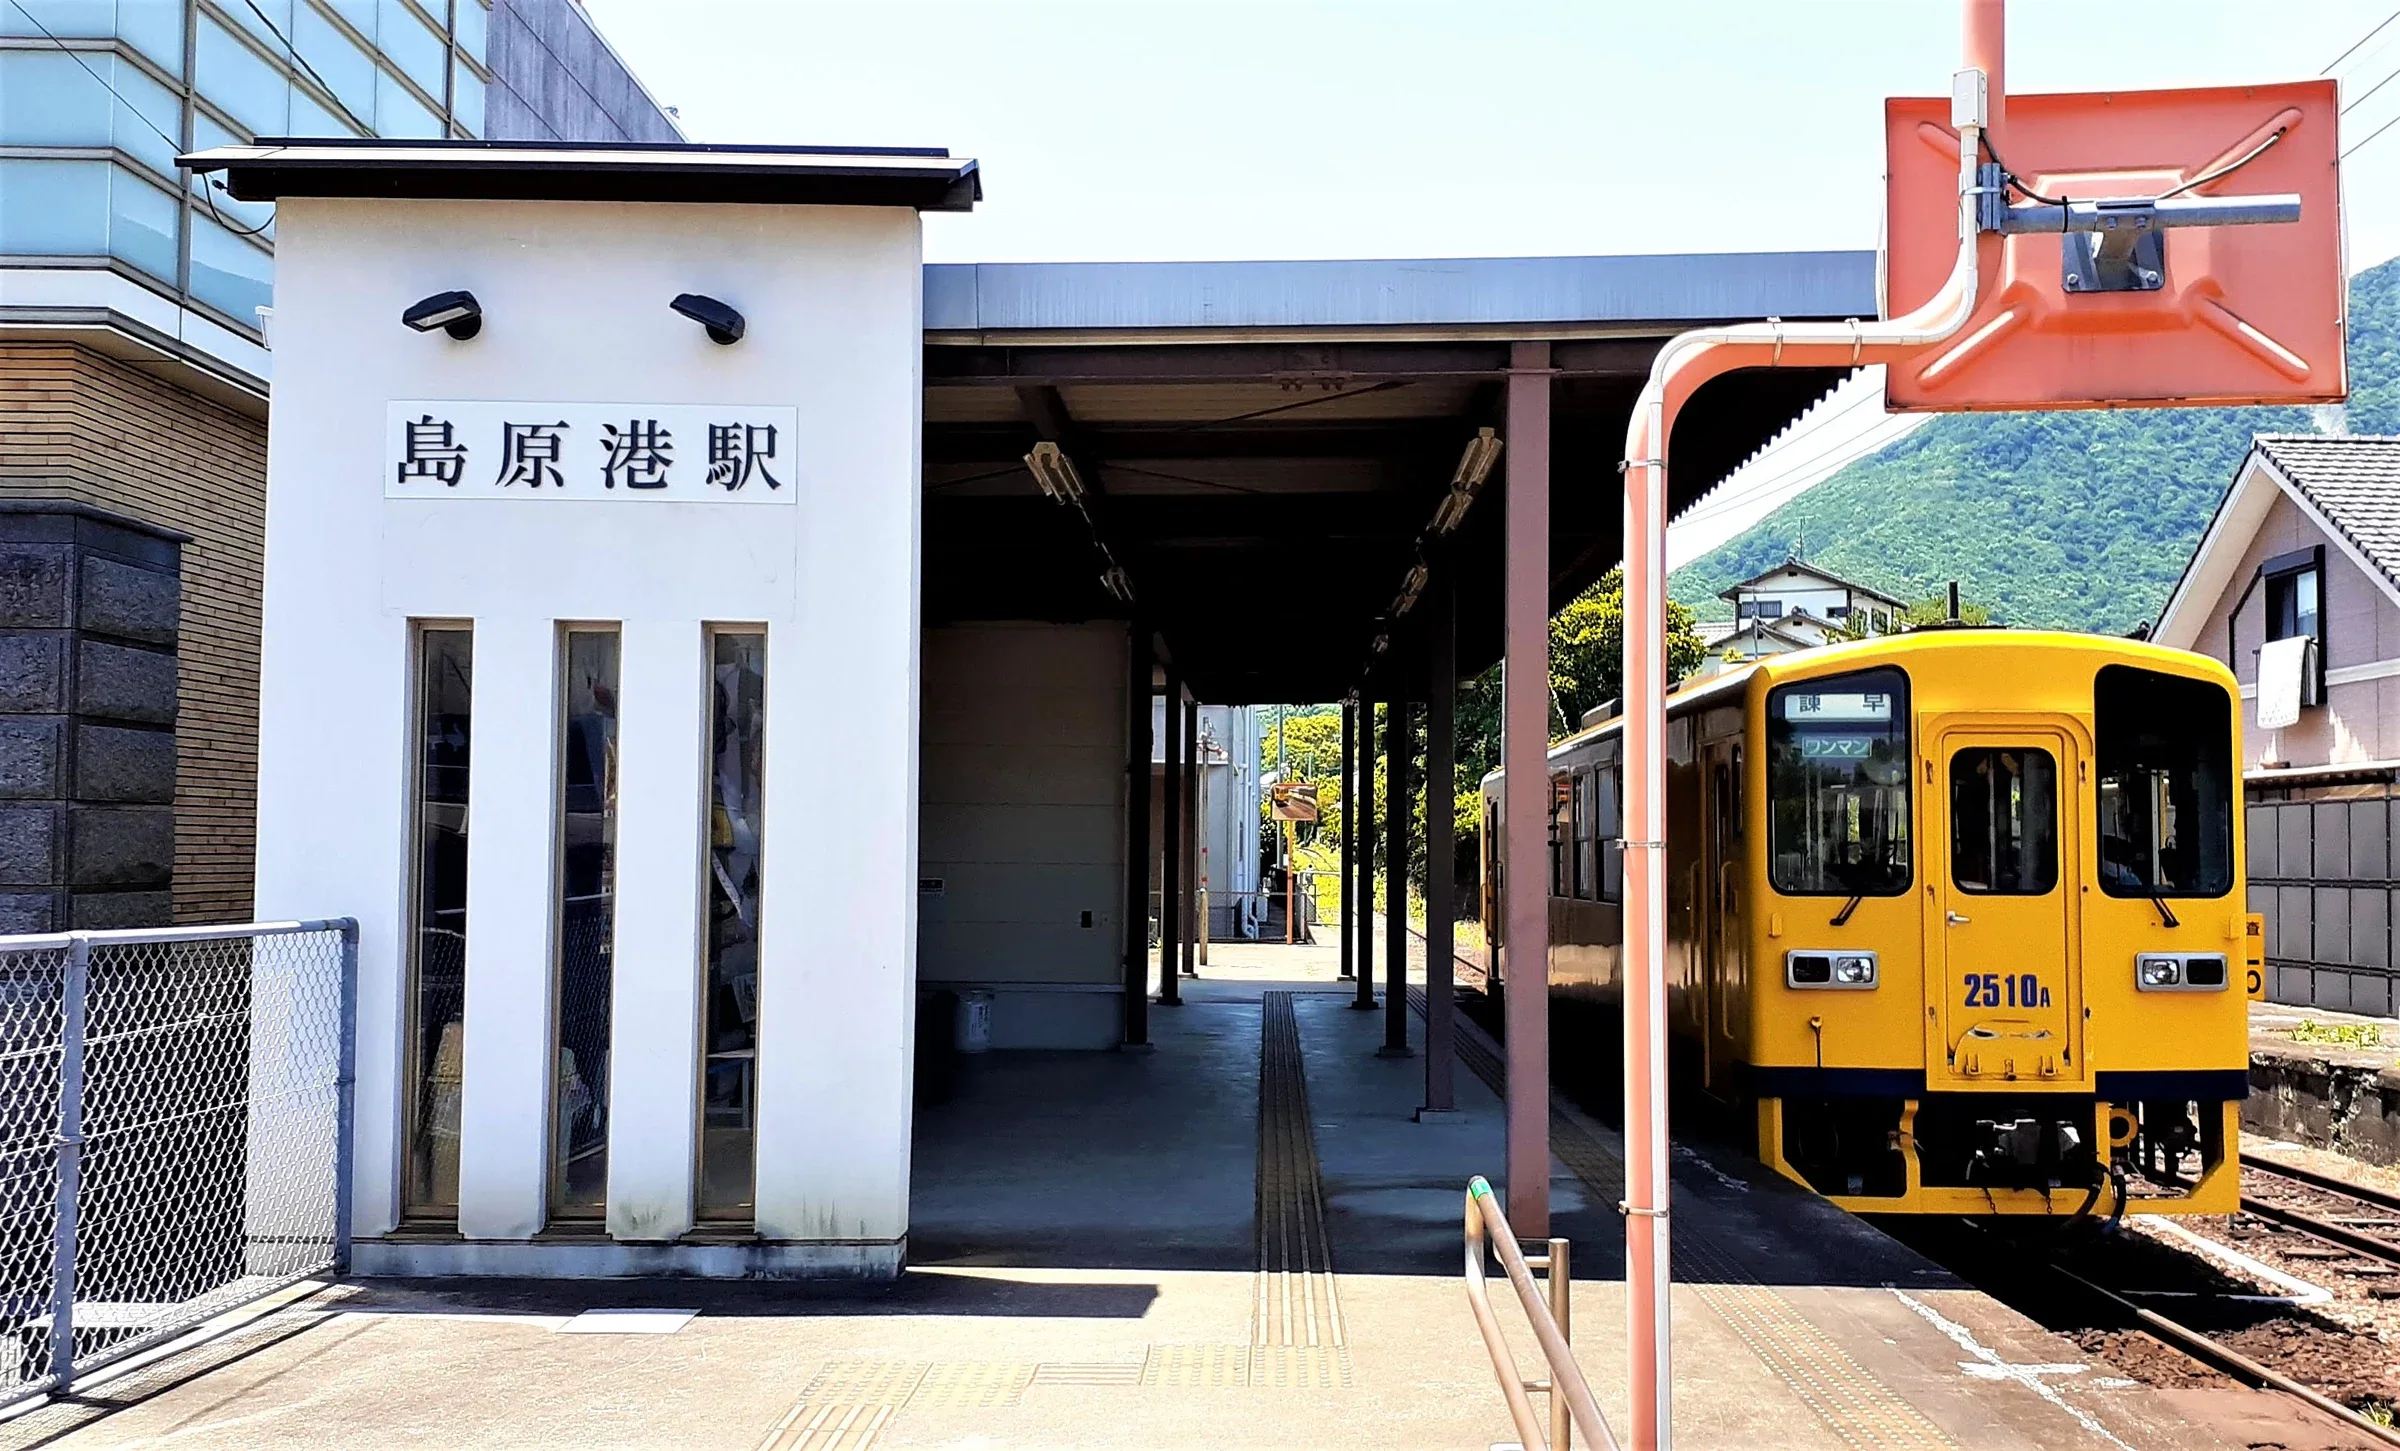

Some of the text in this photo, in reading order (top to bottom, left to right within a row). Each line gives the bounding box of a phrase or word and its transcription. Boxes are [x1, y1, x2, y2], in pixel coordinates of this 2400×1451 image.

[397, 414, 782, 491] 島原港駅
[1805, 739, 1869, 755] ワンマン
[1964, 973, 2051, 1008] 2510A
